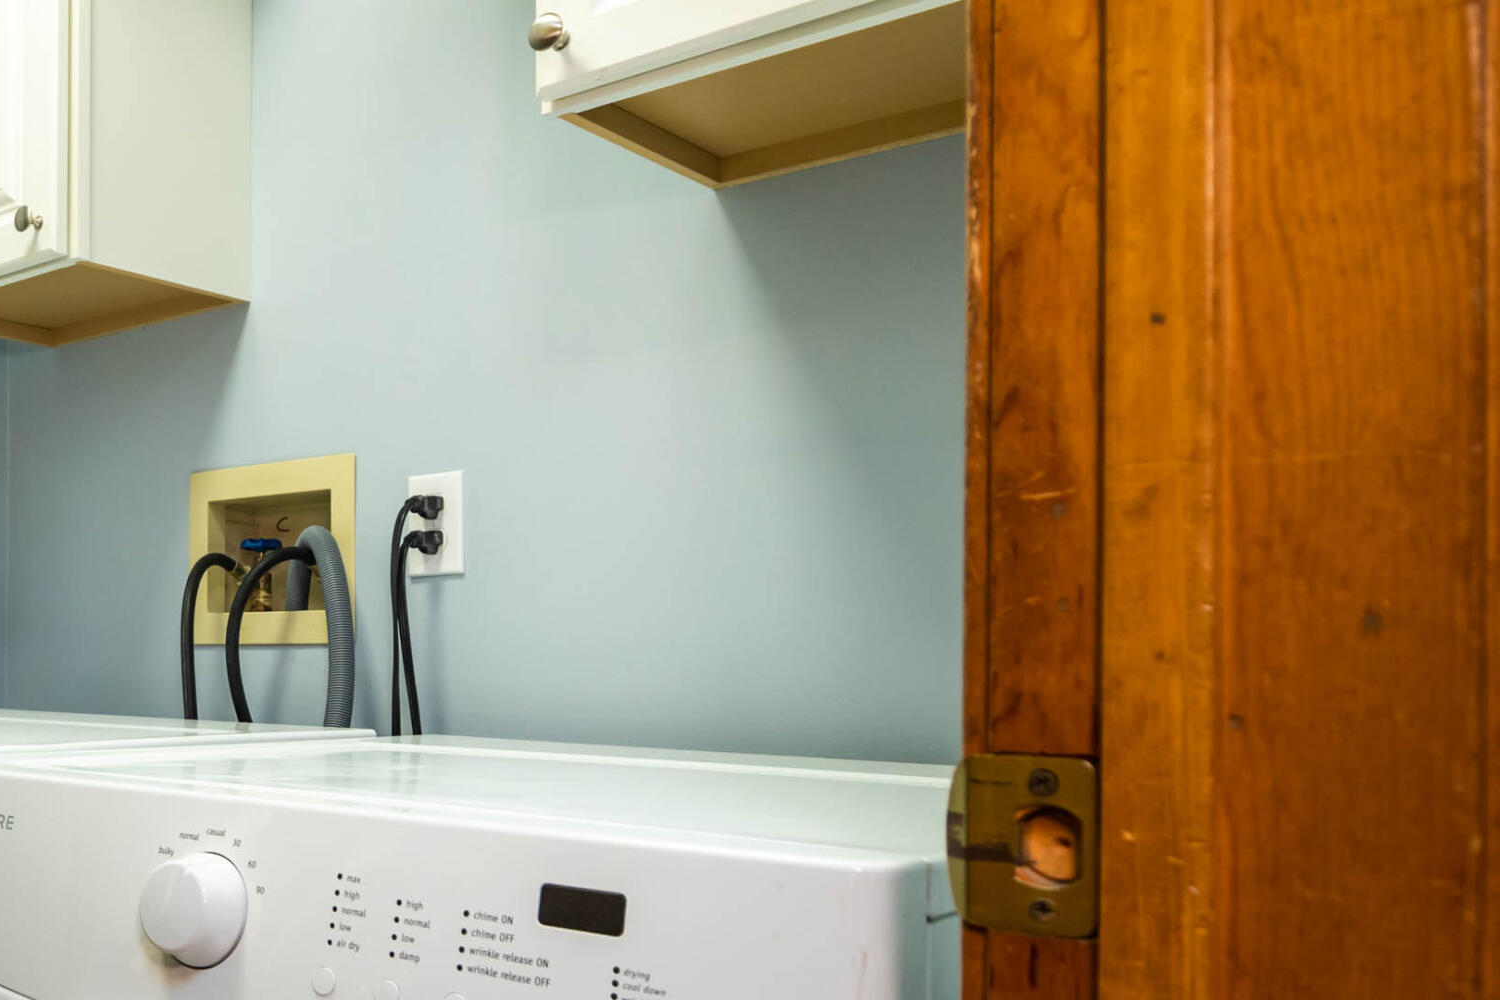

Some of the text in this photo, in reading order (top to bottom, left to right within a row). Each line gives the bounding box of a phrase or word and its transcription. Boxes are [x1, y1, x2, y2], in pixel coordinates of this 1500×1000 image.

[179, 832, 200, 841] normal
[232, 839, 242, 848] 30
[247, 860, 257, 869] 60
[343, 890, 361, 901] high
[406, 899, 424, 911] high
[341, 906, 367, 918] normal
[404, 918, 431, 930] normal
[473, 912, 514, 925] chime ON
[339, 922, 352, 932] low
[401, 934, 415, 944] low
[471, 929, 515, 943] chime OFF
[399, 951, 421, 964] damp
[469, 947, 550, 968] wrinkle release ON
[467, 965, 551, 988] wrinkle release OFF
[623, 968, 651, 982] drying
[622, 982, 667, 996] cool down
